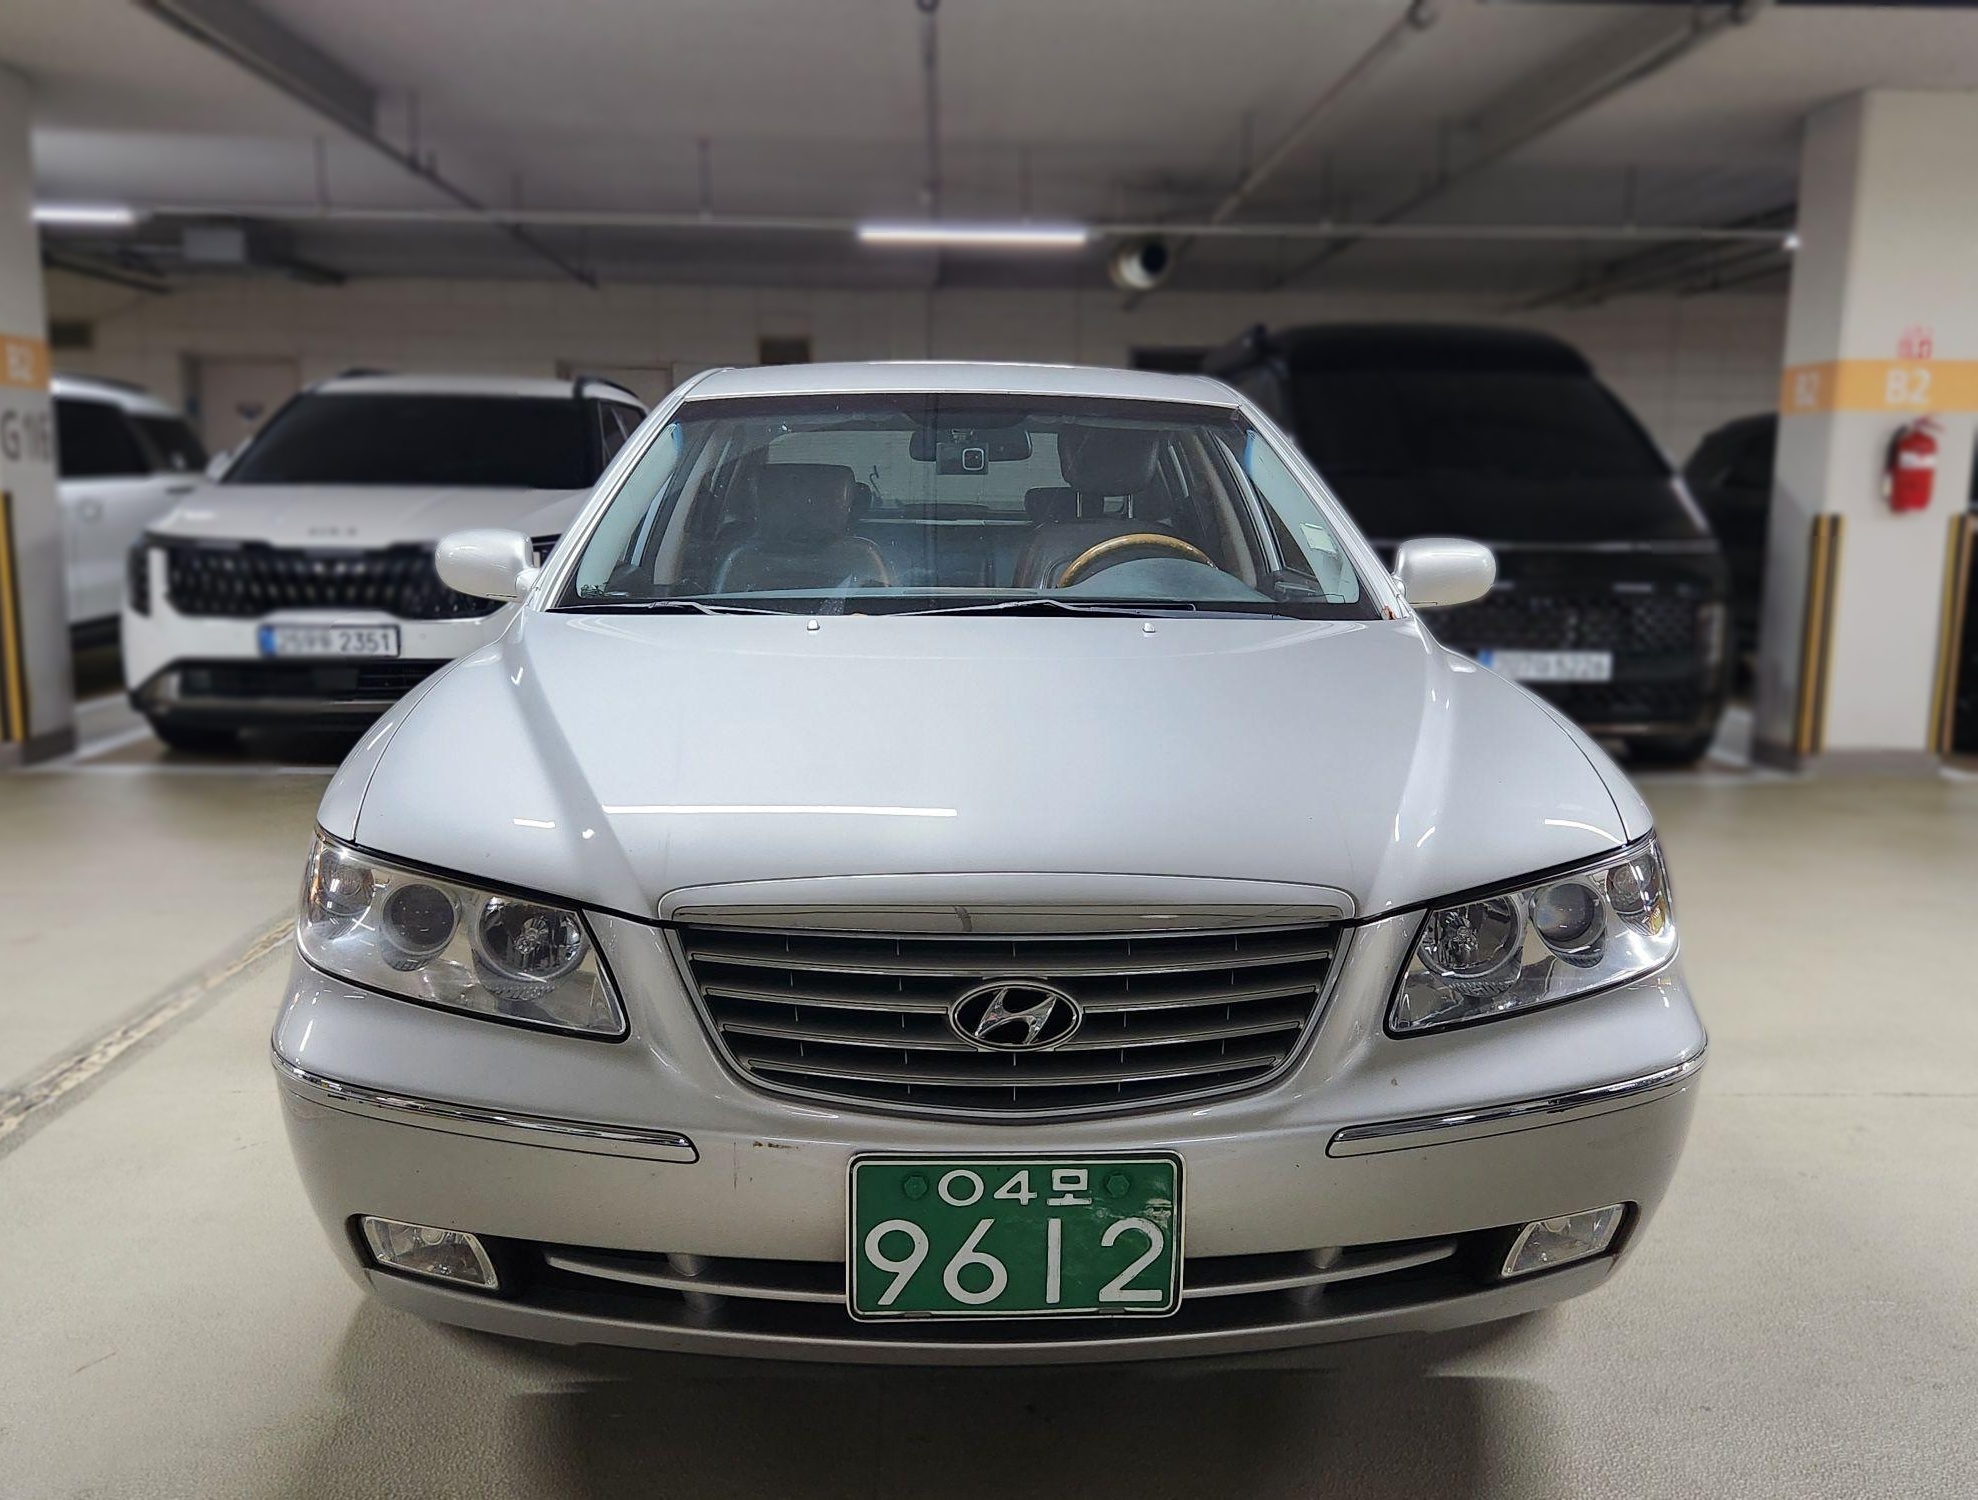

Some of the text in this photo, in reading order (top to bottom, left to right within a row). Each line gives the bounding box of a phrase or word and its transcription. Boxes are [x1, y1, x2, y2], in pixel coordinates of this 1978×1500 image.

[1885, 367, 1931, 405] B2
[340, 631, 390, 653] 2351
[938, 1169, 1092, 1206] 04모
[865, 1217, 1164, 1305] 9612
